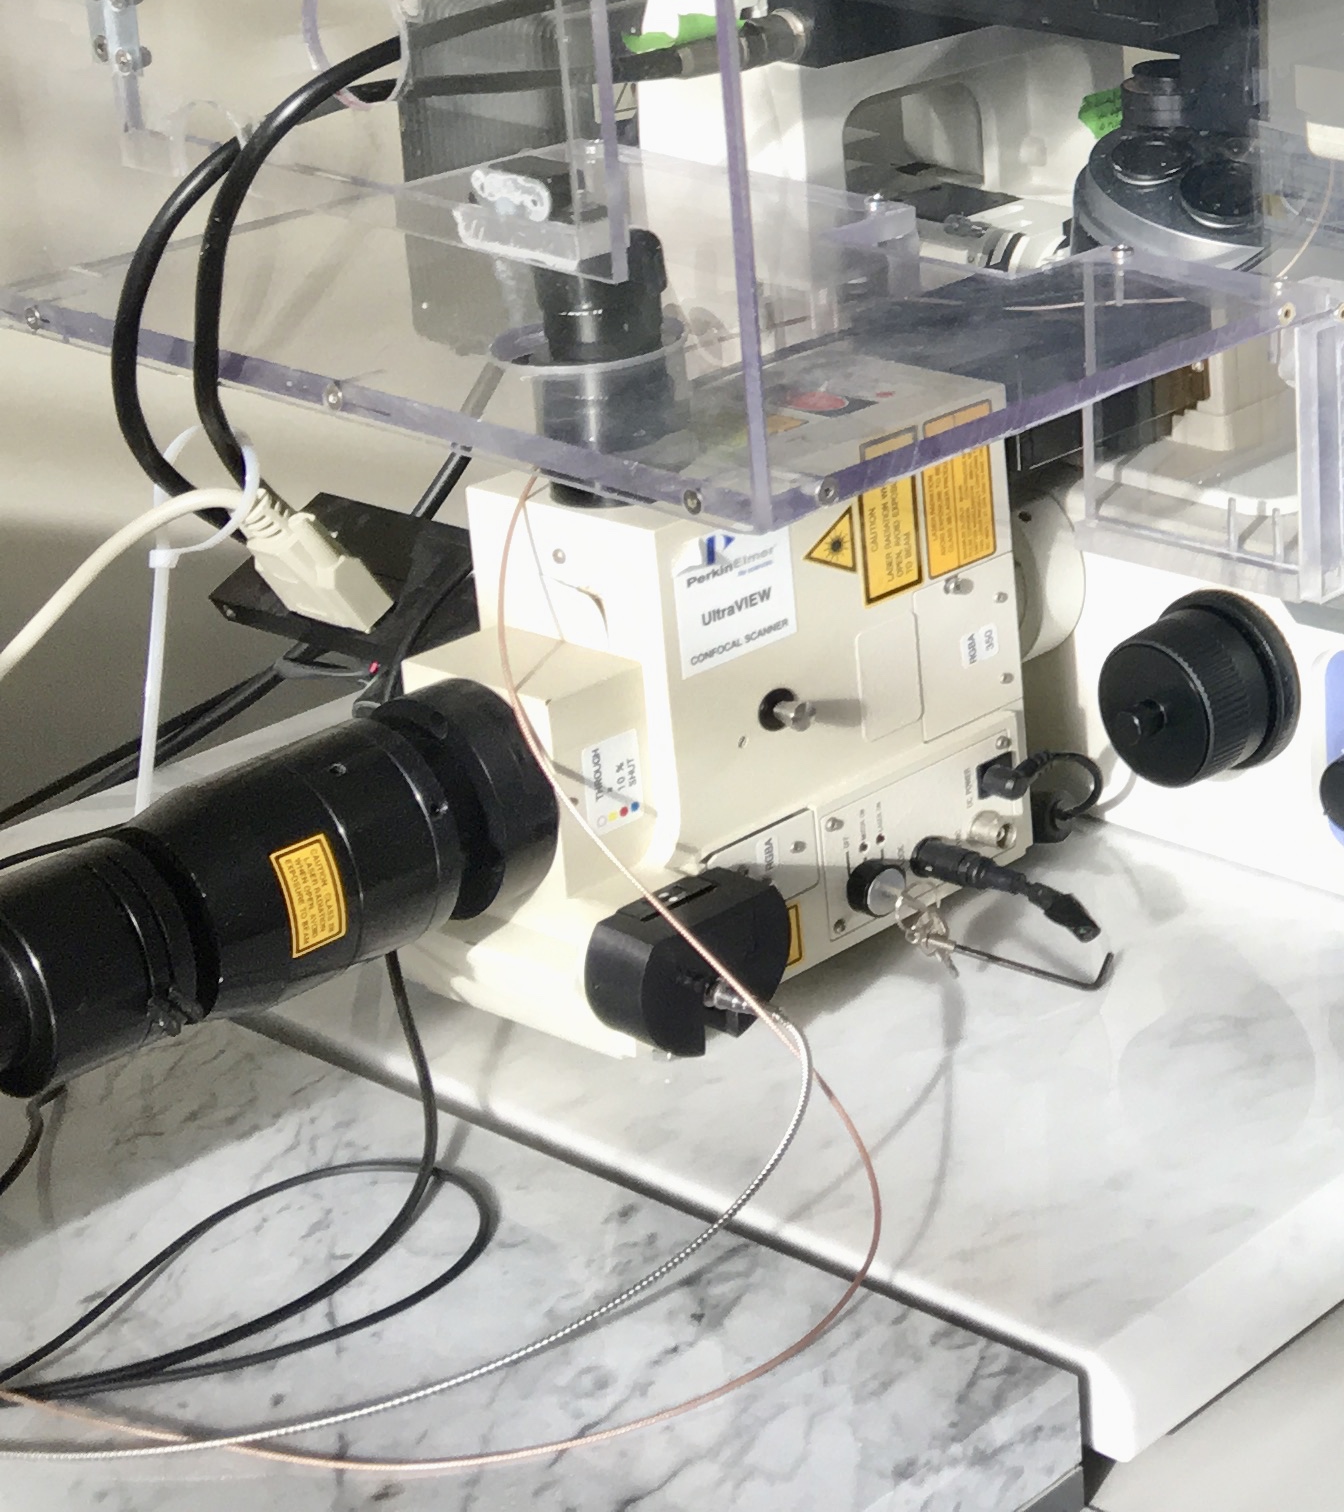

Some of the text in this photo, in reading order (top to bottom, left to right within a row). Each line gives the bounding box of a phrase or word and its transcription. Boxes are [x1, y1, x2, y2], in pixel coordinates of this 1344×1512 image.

[868, 506, 879, 553] CAUTION
[686, 543, 777, 588] PerkinElmer
[904, 560, 914, 576] TO
[701, 586, 773, 627] UltraVIEW
[690, 617, 790, 666] CONFOCAL SCANNER
[984, 629, 995, 651] 350
[626, 758, 637, 787] SHUT
[284, 858, 311, 945] EXPOSURE TO BEAM
[303, 856, 327, 933] LASER RADIATION
